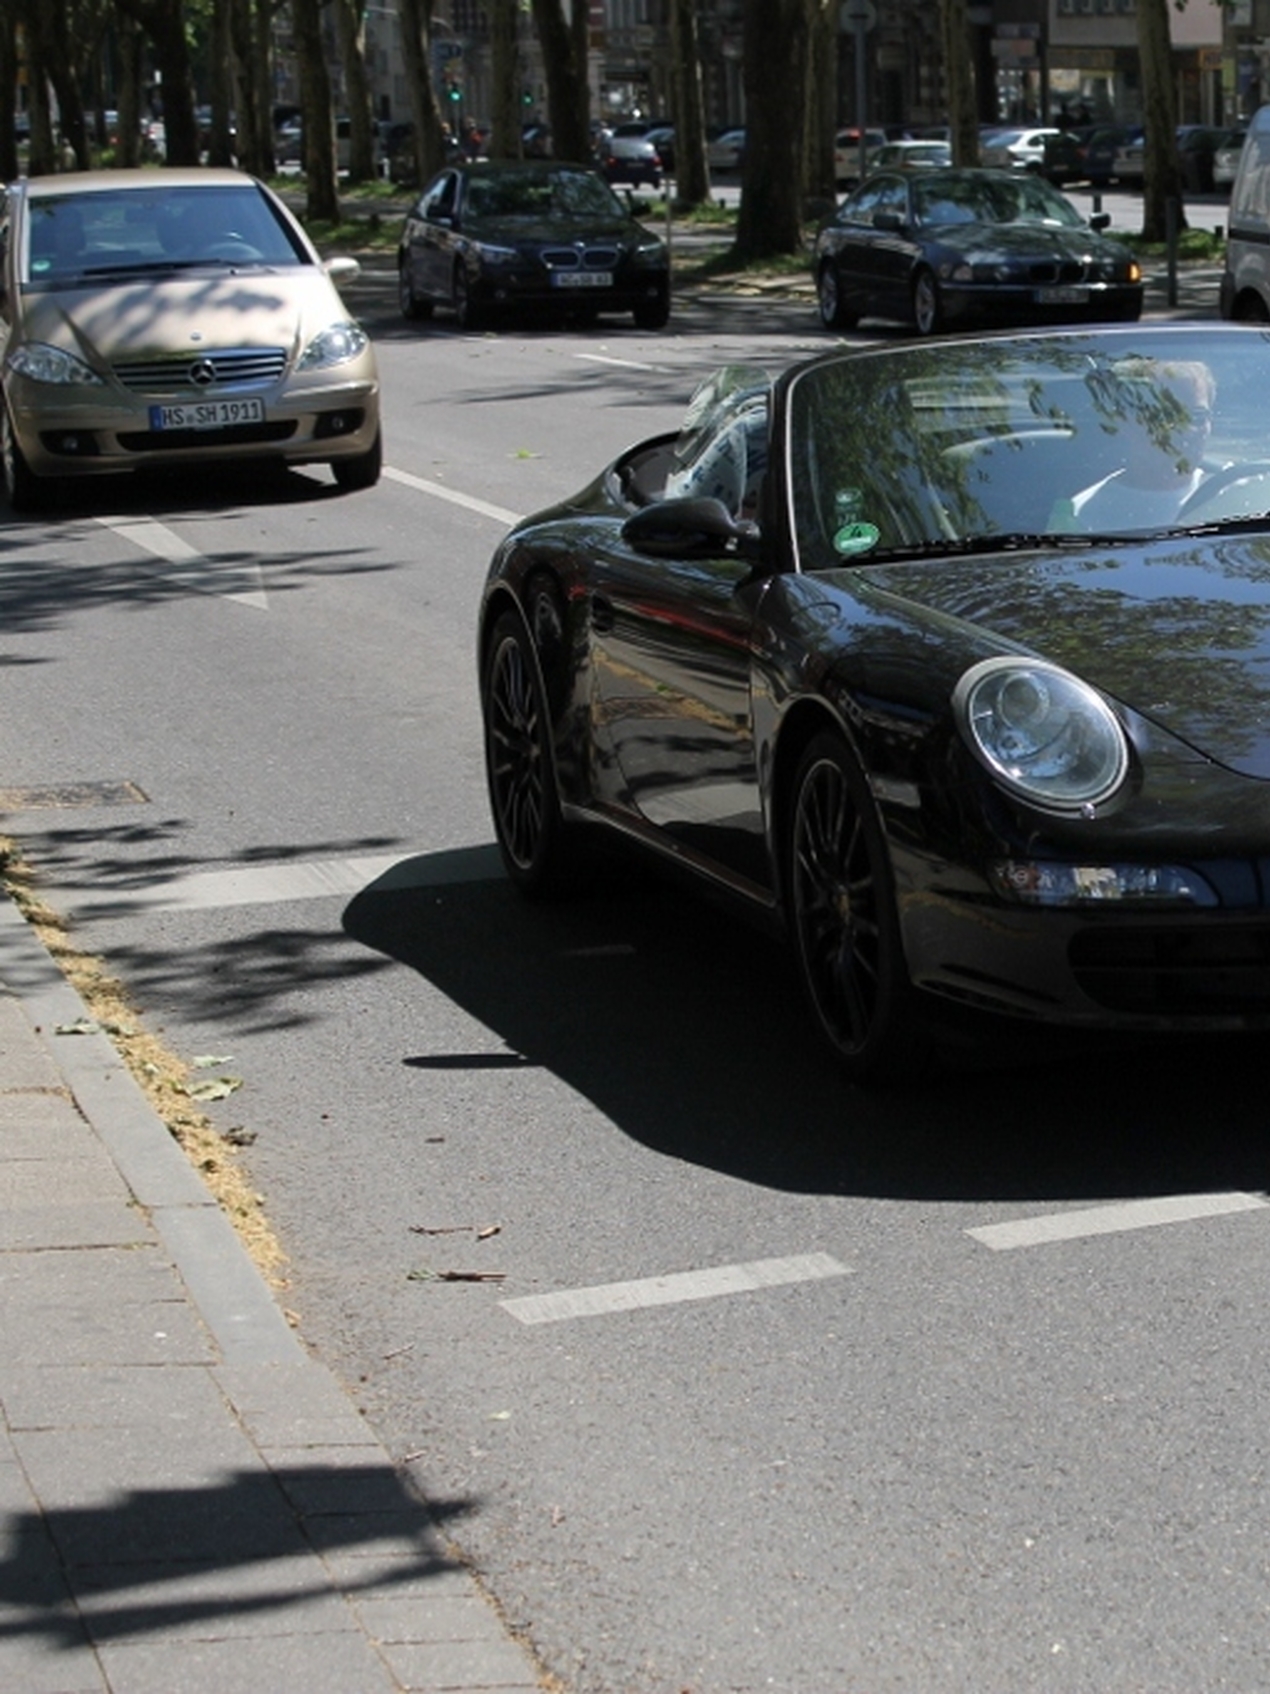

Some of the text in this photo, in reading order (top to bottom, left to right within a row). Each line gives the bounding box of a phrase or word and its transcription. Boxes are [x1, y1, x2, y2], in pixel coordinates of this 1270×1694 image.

[162, 401, 259, 426] HS SH 1911
